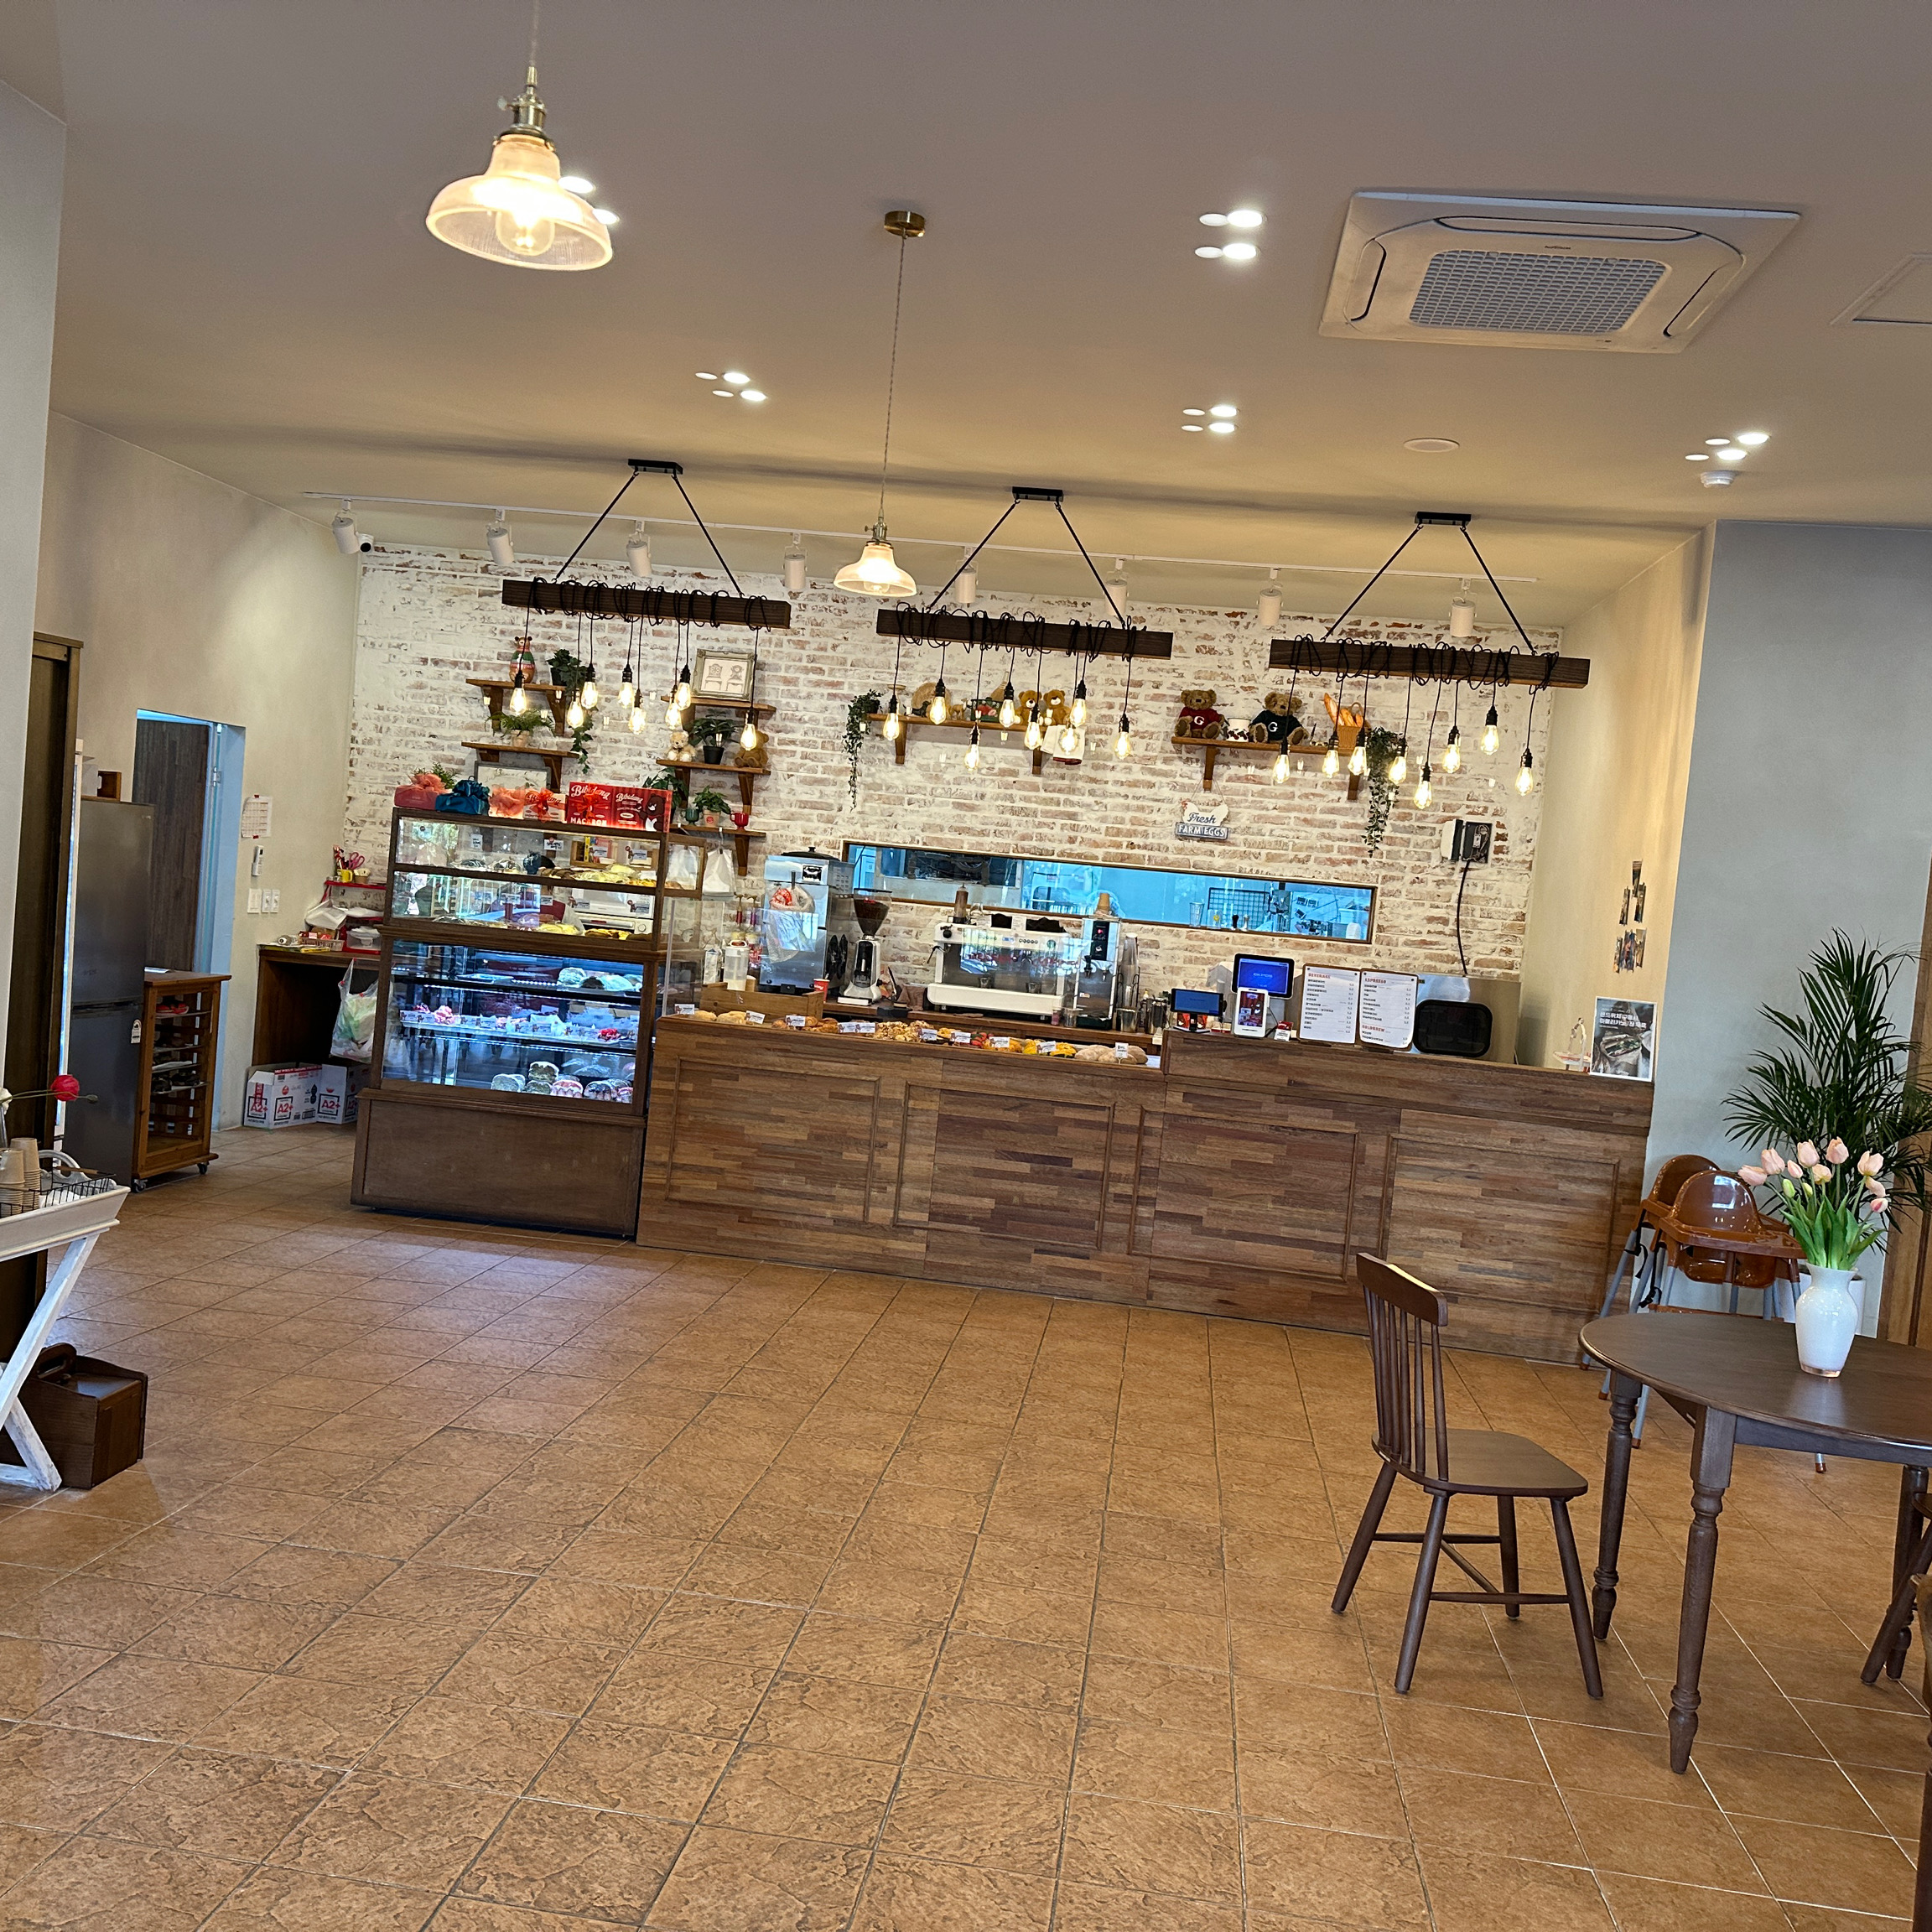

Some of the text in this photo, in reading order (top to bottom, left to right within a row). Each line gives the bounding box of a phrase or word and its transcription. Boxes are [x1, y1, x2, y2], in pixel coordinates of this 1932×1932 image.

[1194, 716, 1205, 725] G
[1268, 721, 1278, 732] G
[1187, 812, 1217, 823] Fresh
[1178, 824, 1224, 837] FARM EGGS
[277, 1103, 293, 1114] A2+
[322, 1099, 340, 1109] A2+
